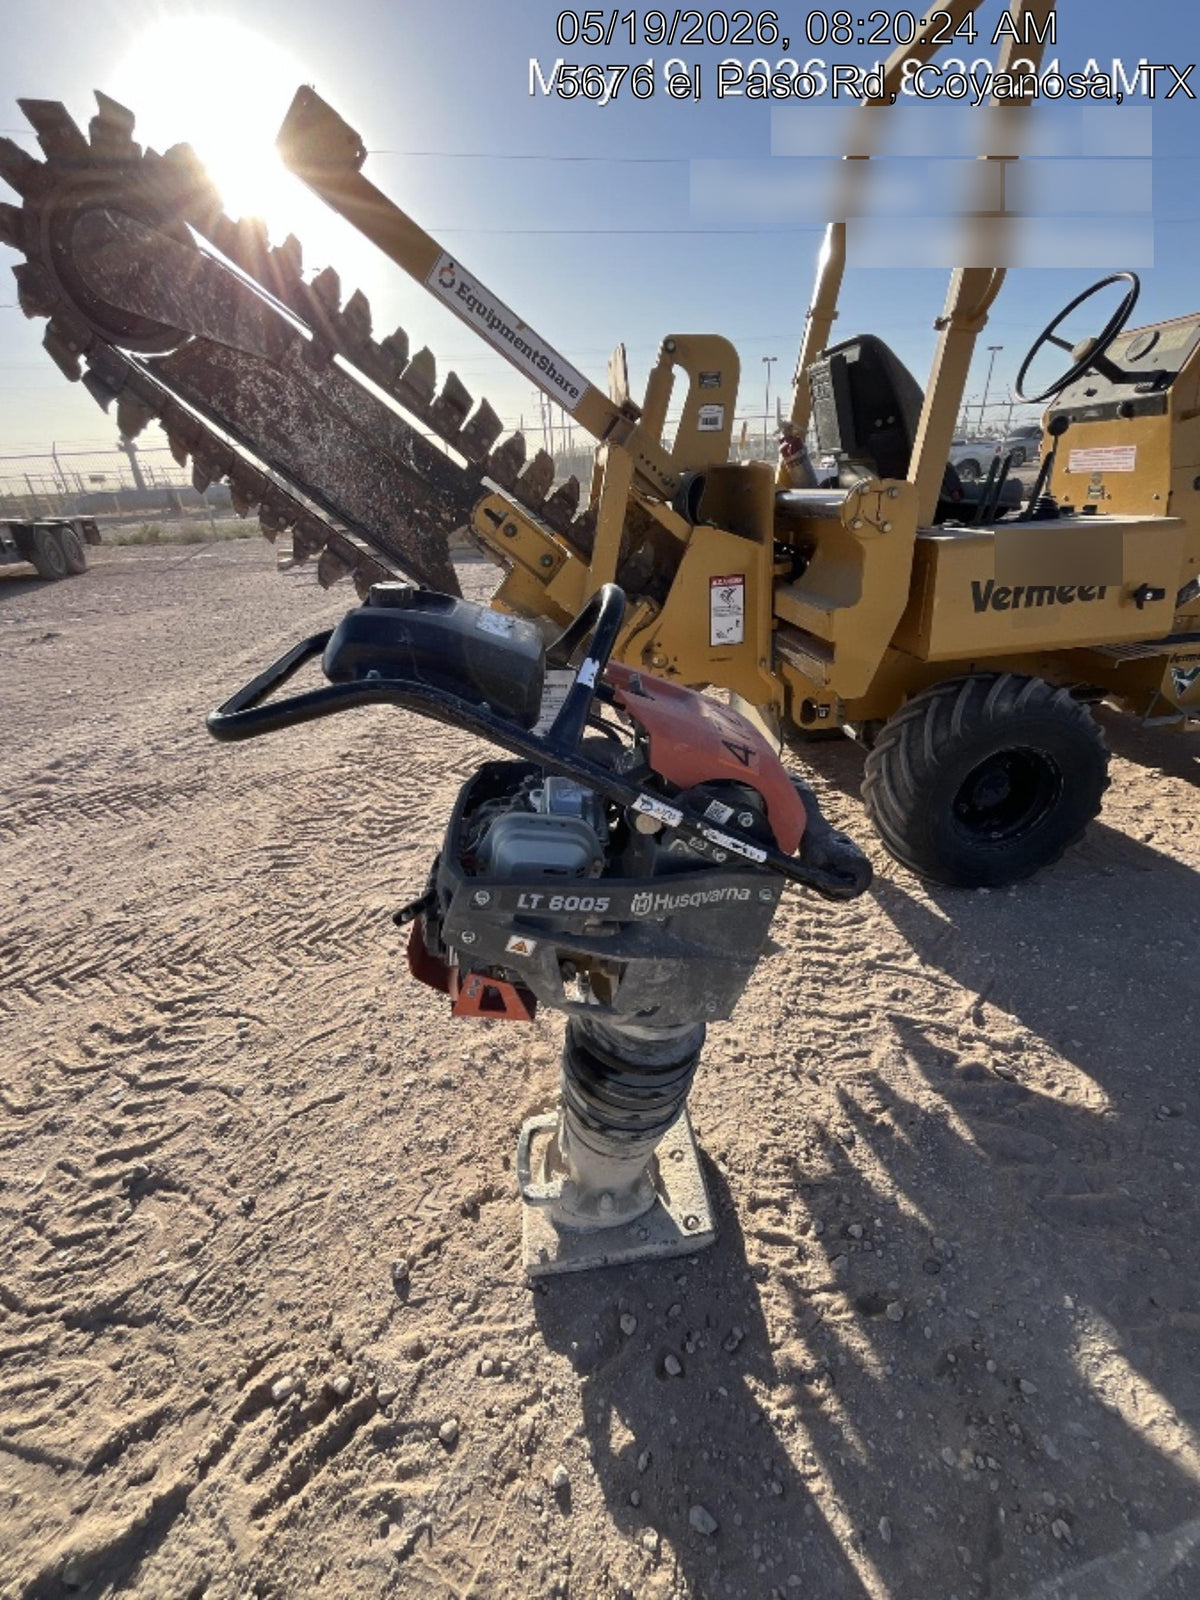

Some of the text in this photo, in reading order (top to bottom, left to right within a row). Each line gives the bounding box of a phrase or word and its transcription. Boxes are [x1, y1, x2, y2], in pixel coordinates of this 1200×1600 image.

[455, 281, 581, 399] EquipmentShare
[517, 893, 545, 909] LT
[653, 887, 751, 911] Husqvarna
